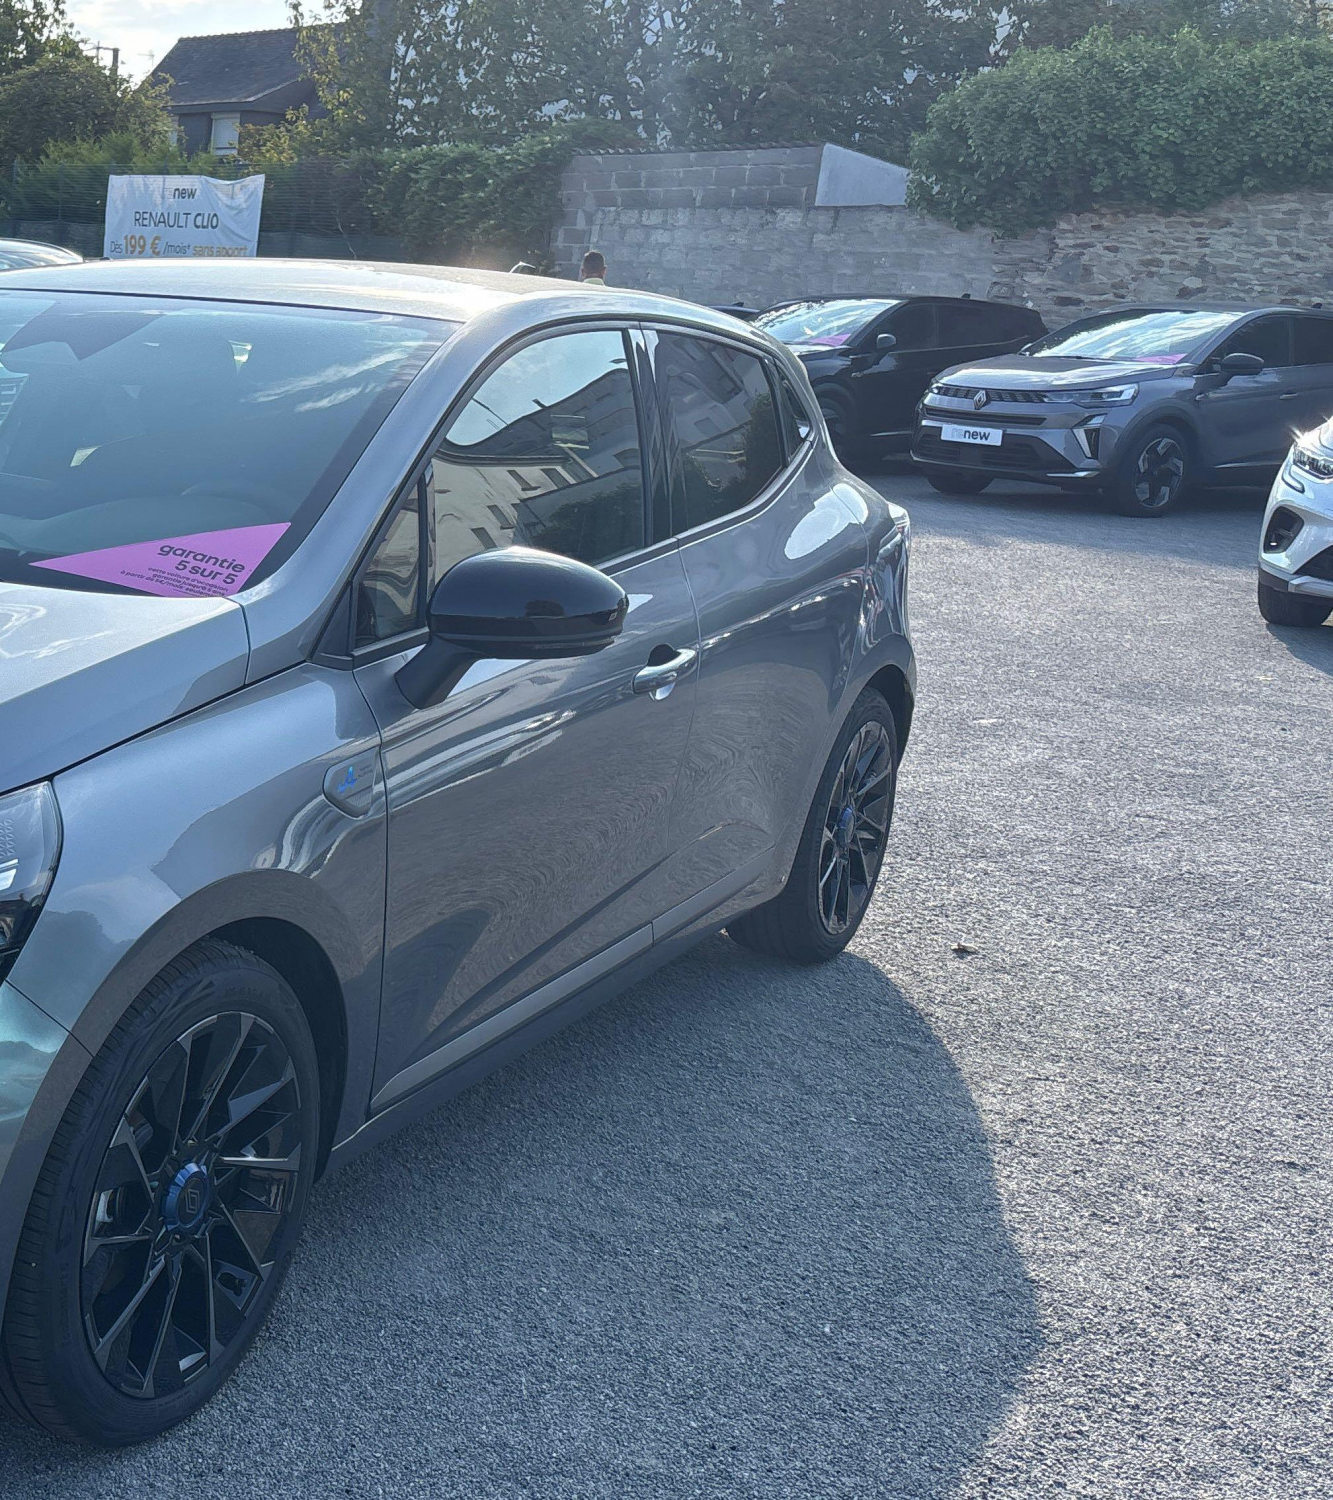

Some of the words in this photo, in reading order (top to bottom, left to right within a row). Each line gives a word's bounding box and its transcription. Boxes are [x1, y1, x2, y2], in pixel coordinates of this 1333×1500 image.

[133, 211, 191, 228] RENAULT
[193, 212, 219, 230] CLIO
[123, 234, 146, 255] 199
[192, 245, 214, 257] sans
[951, 427, 991, 441] renew
[157, 545, 246, 573] garantie
[174, 560, 192, 571] 5
[188, 565, 223, 580] sur
[222, 573, 238, 585] 5
